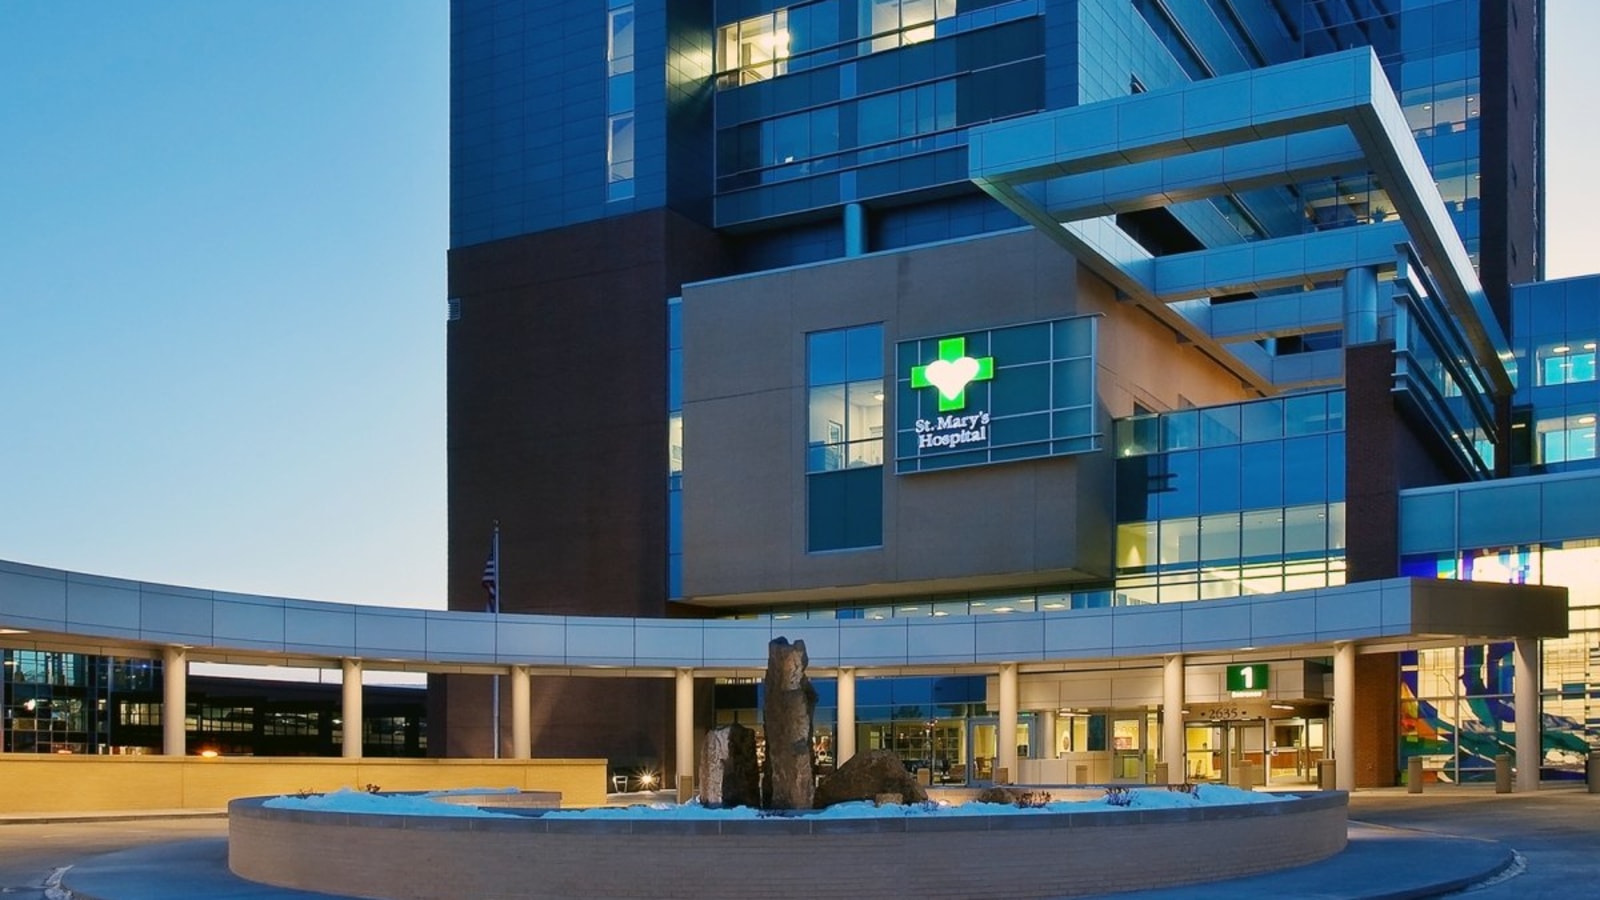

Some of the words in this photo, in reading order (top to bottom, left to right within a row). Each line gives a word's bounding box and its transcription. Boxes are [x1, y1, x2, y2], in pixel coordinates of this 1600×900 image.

[915, 419, 935, 433] St.
[936, 410, 990, 430] Mary's
[918, 425, 987, 448] Hospital
[1240, 666, 1253, 689] 1
[1208, 708, 1238, 719] 2635
